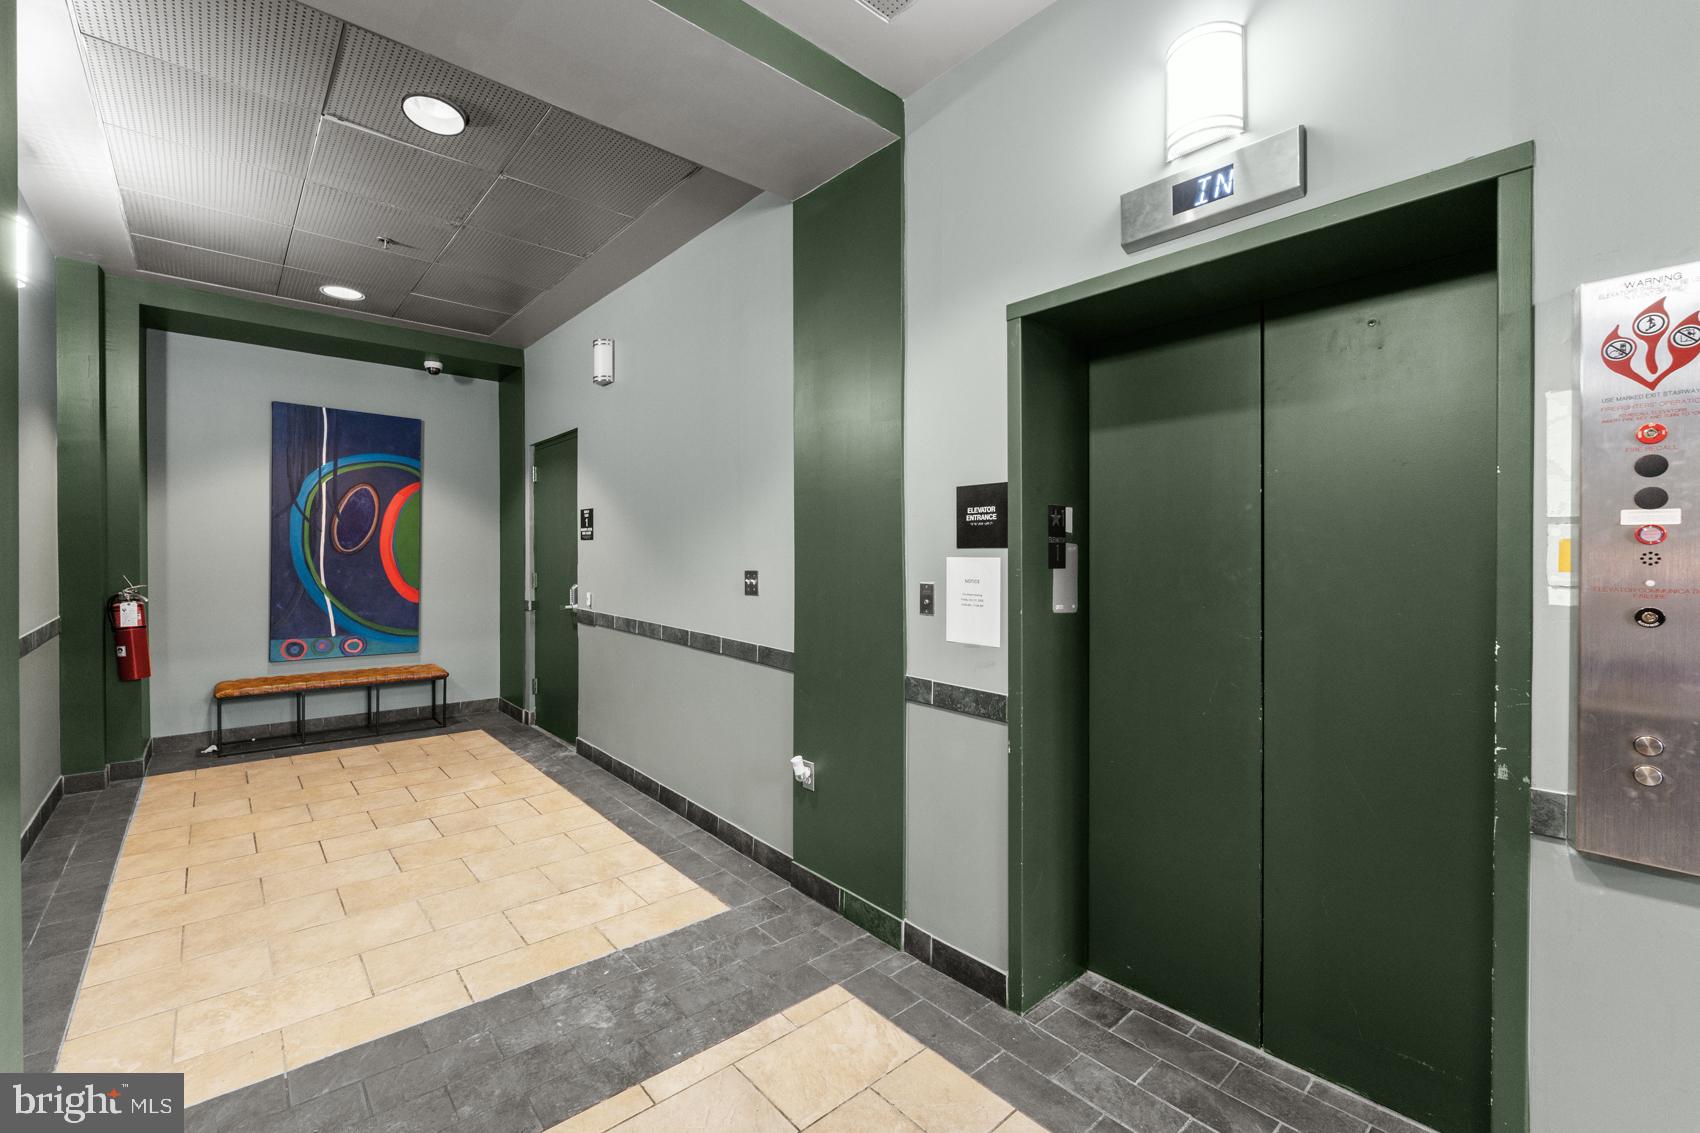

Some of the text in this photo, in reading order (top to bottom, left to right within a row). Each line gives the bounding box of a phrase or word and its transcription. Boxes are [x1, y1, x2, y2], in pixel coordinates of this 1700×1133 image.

[1193, 168, 1235, 207] IN
[1624, 272, 1683, 288] WARNING
[1616, 394, 1644, 402] MARKED
[1645, 391, 1661, 399] EXIT
[967, 505, 996, 514] ELEVATOR
[965, 513, 998, 522] ENTRANCE
